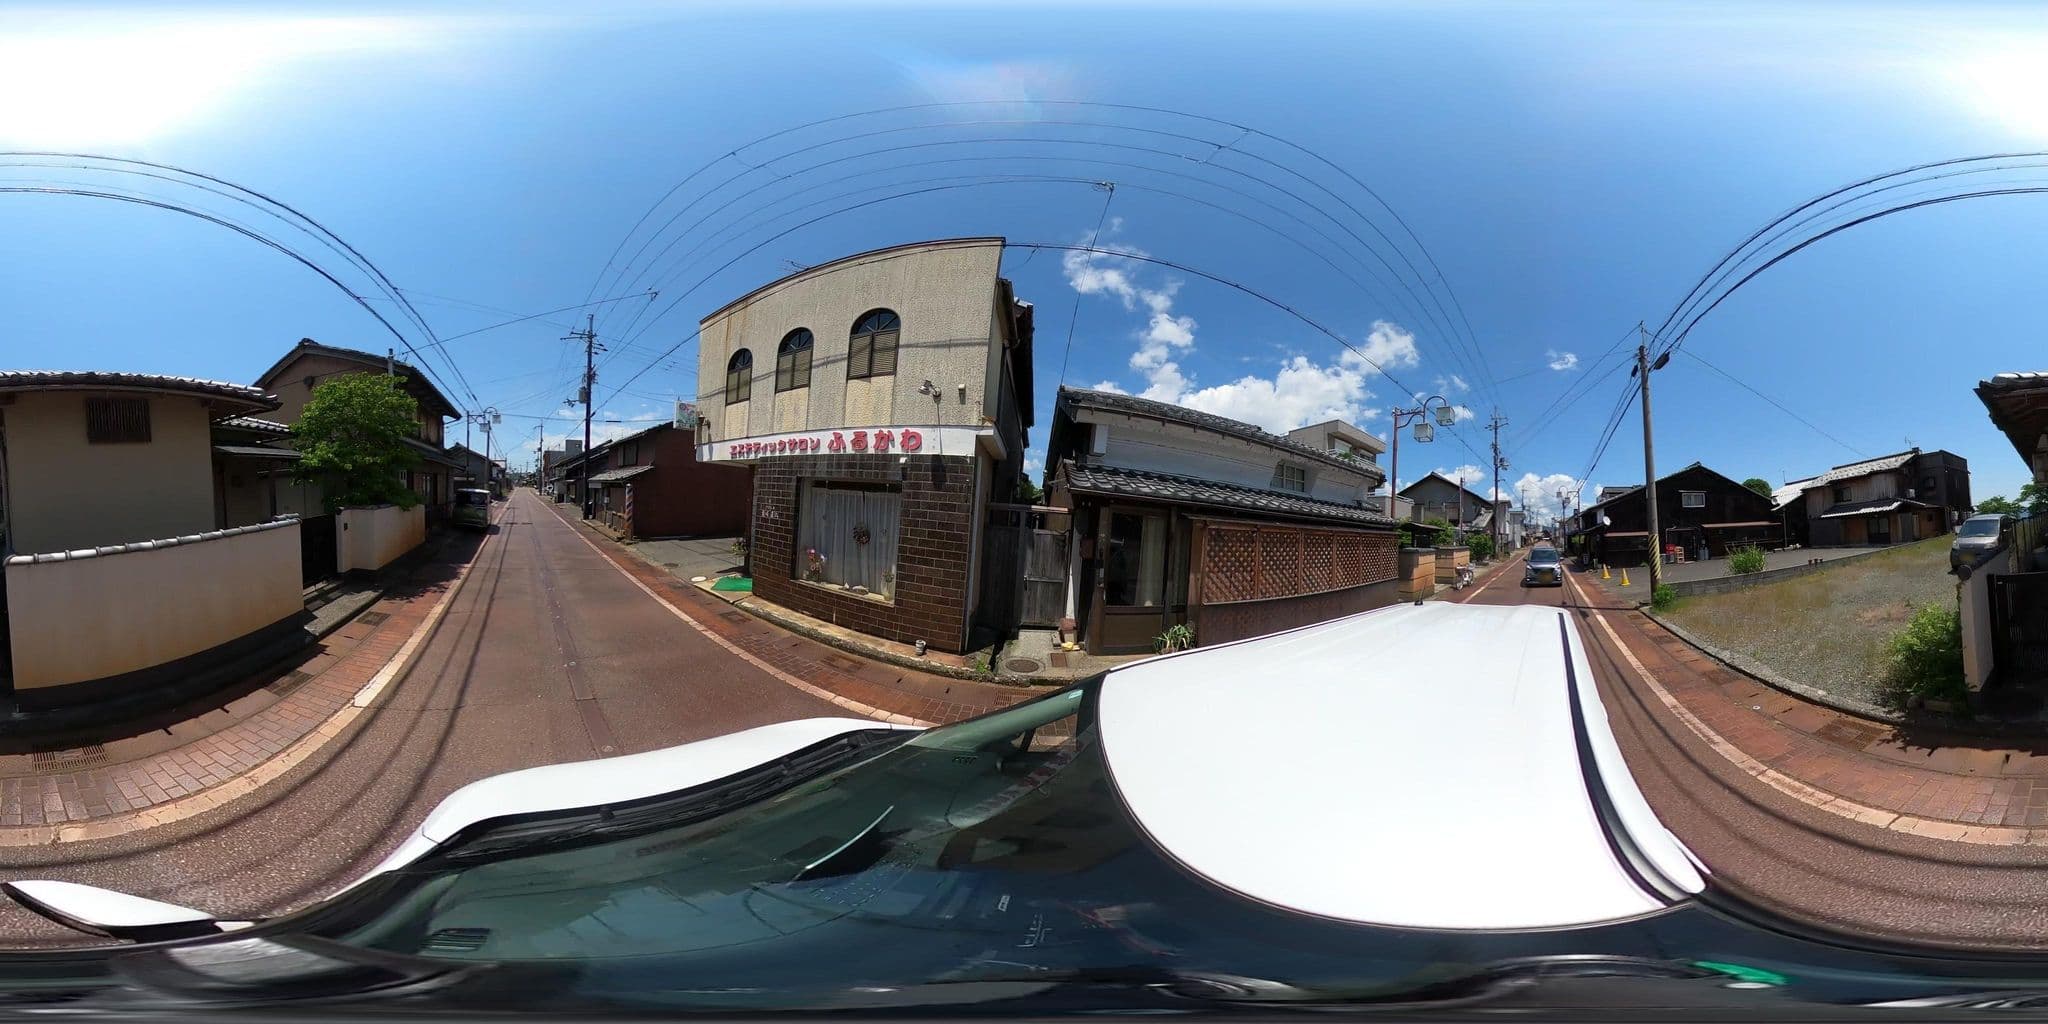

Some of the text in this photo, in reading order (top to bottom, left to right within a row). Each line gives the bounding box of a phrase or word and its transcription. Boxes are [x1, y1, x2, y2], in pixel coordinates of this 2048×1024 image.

[729, 428, 923, 457] エステティックサロン ふるかわ
